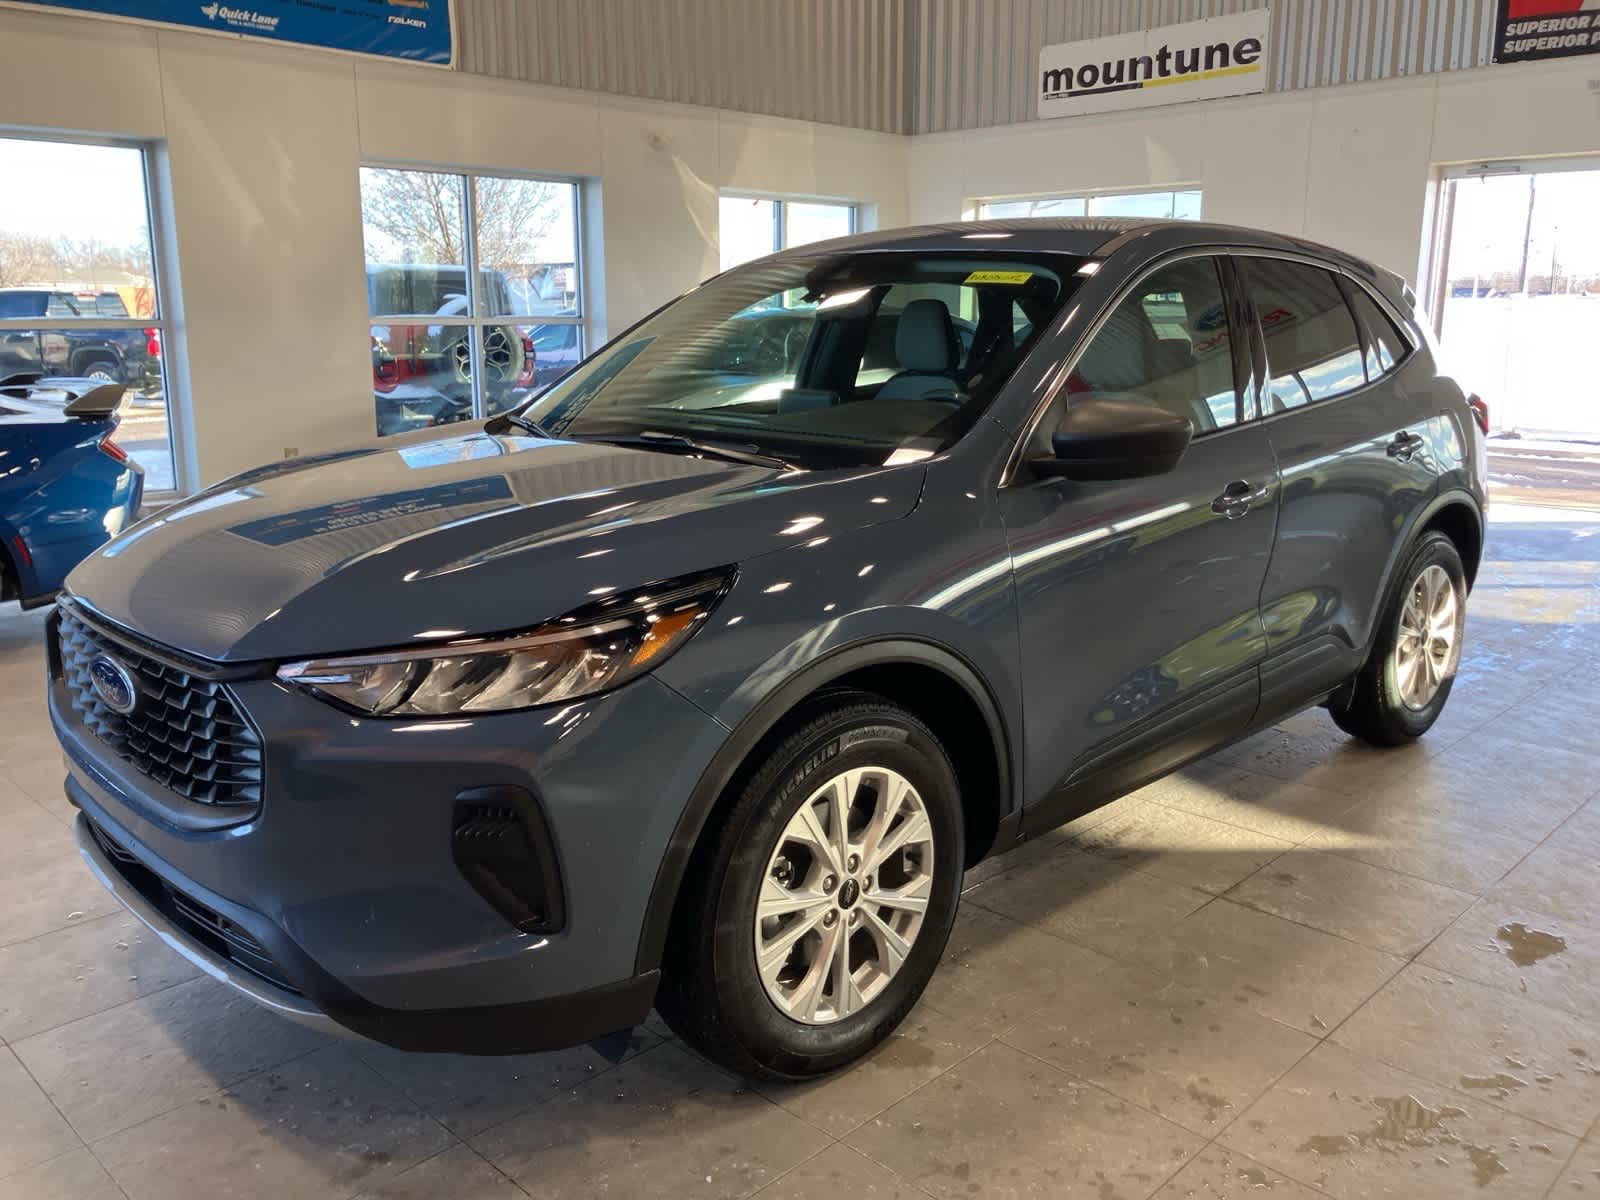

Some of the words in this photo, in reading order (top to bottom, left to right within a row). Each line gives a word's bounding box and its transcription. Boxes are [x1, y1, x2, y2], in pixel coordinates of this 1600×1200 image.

[219, 7, 250, 20] Quick
[251, 12, 279, 26] Lane
[388, 16, 426, 29] FALKEN
[1505, 15, 1591, 37] SUPERIOR
[1503, 33, 1590, 54] SUPERIOR
[1042, 37, 1262, 94] mountune
[769, 742, 838, 818] MICHELIN
